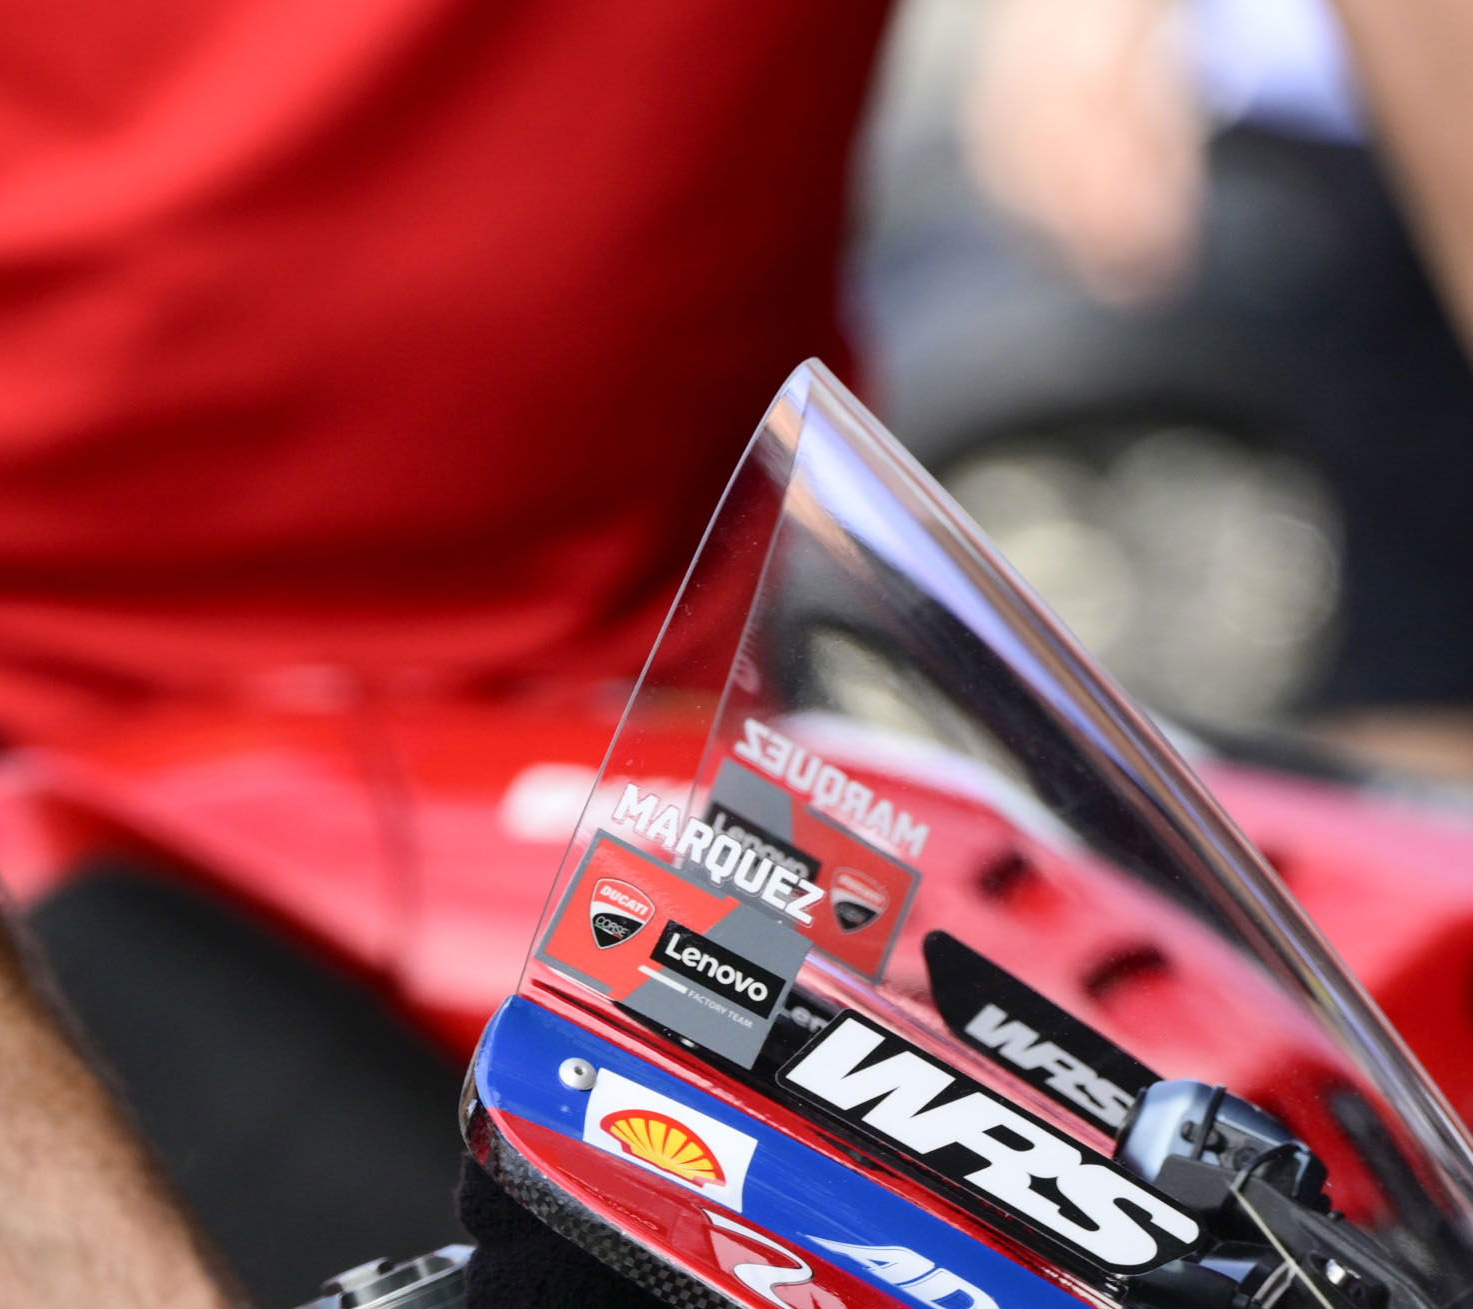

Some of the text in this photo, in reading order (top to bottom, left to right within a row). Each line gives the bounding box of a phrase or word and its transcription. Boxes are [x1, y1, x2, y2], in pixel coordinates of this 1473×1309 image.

[611, 782, 825, 925] MARQUEZ
[594, 915, 629, 938] CORSE
[599, 884, 649, 916] DUCATI
[664, 932, 769, 1002] Lenovo
[687, 989, 754, 1029] FACTORY TEAM
[962, 1003, 1135, 1129] WRS
[785, 1016, 1200, 1267] WRS
